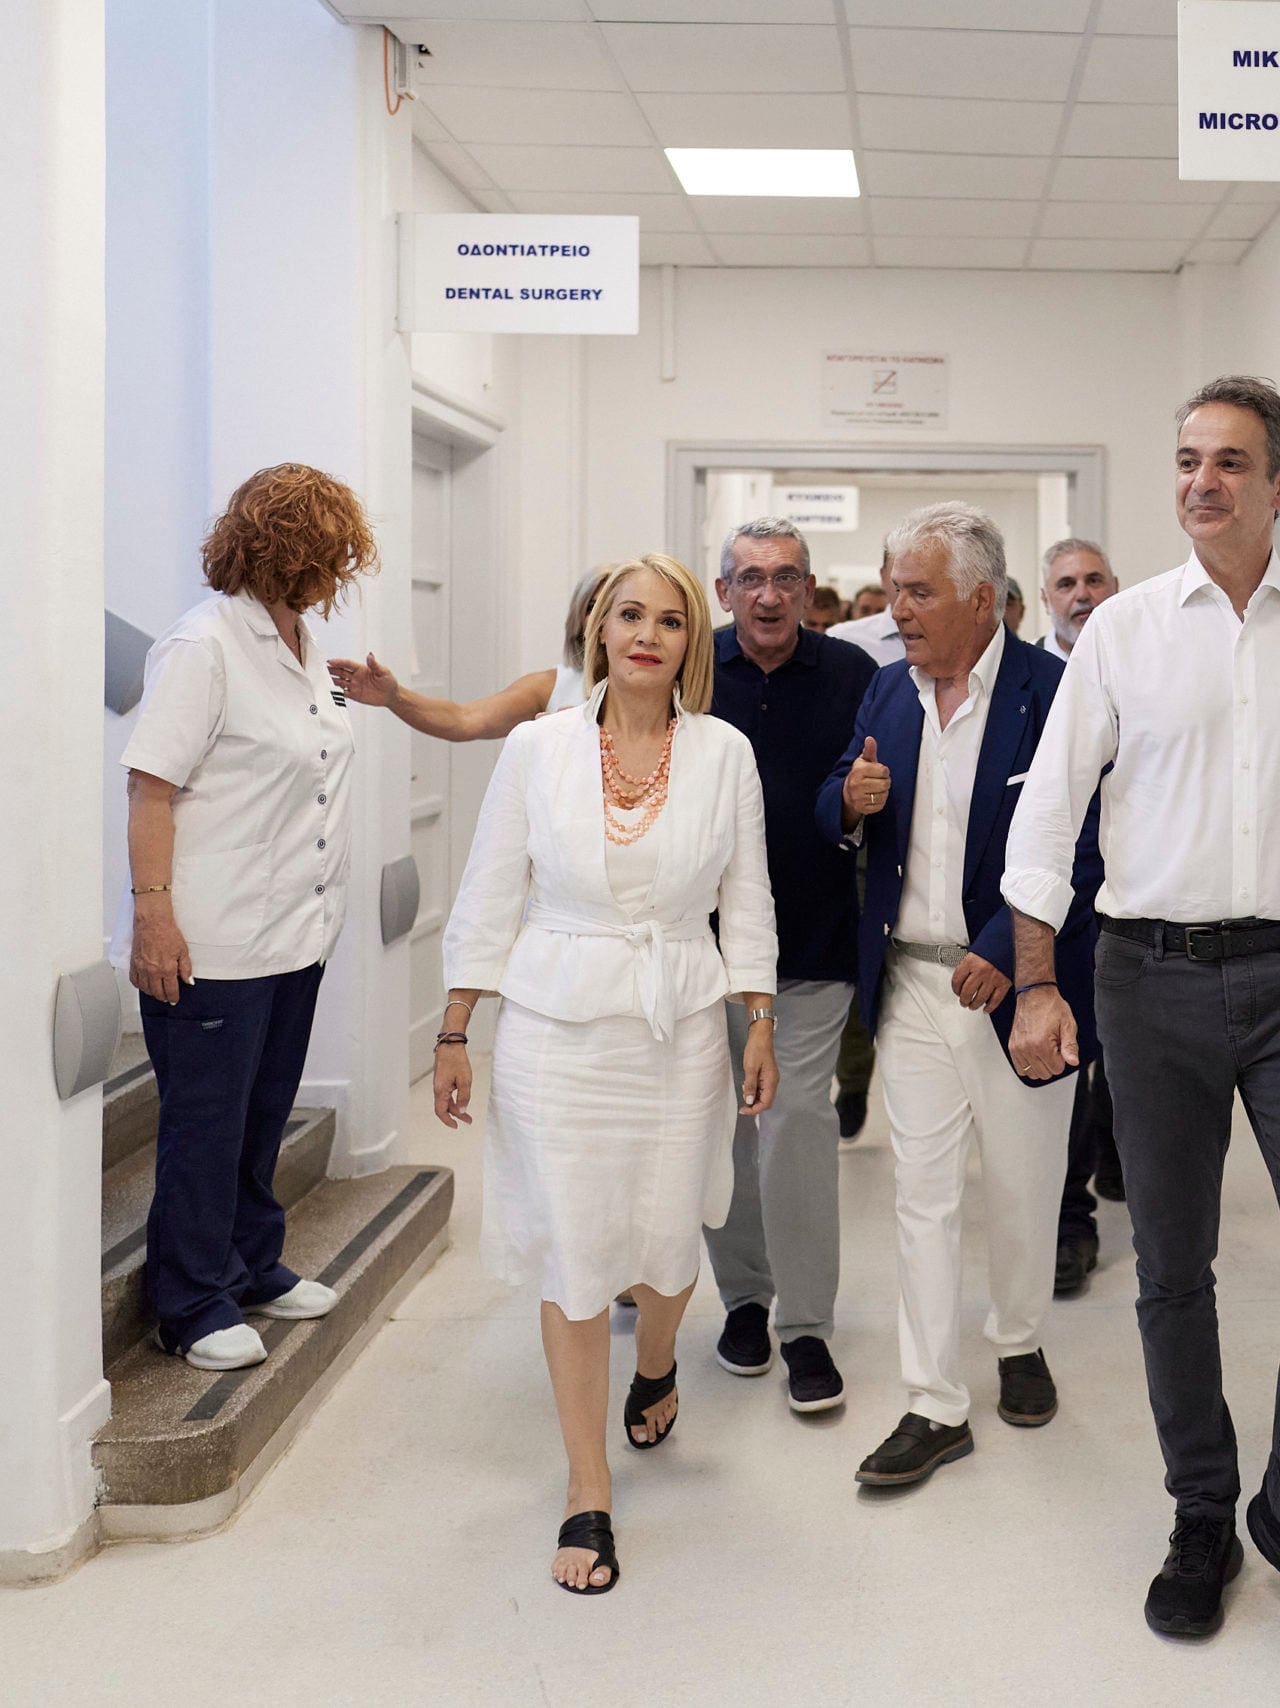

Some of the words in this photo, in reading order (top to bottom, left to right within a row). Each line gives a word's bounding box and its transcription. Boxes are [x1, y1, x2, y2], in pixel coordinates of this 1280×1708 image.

[457, 244, 590, 257] ΟΔΟΝΤΙΑΤΡΕΙΟ
[445, 288, 514, 300] DENTAL
[520, 288, 602, 301] SURGERY
